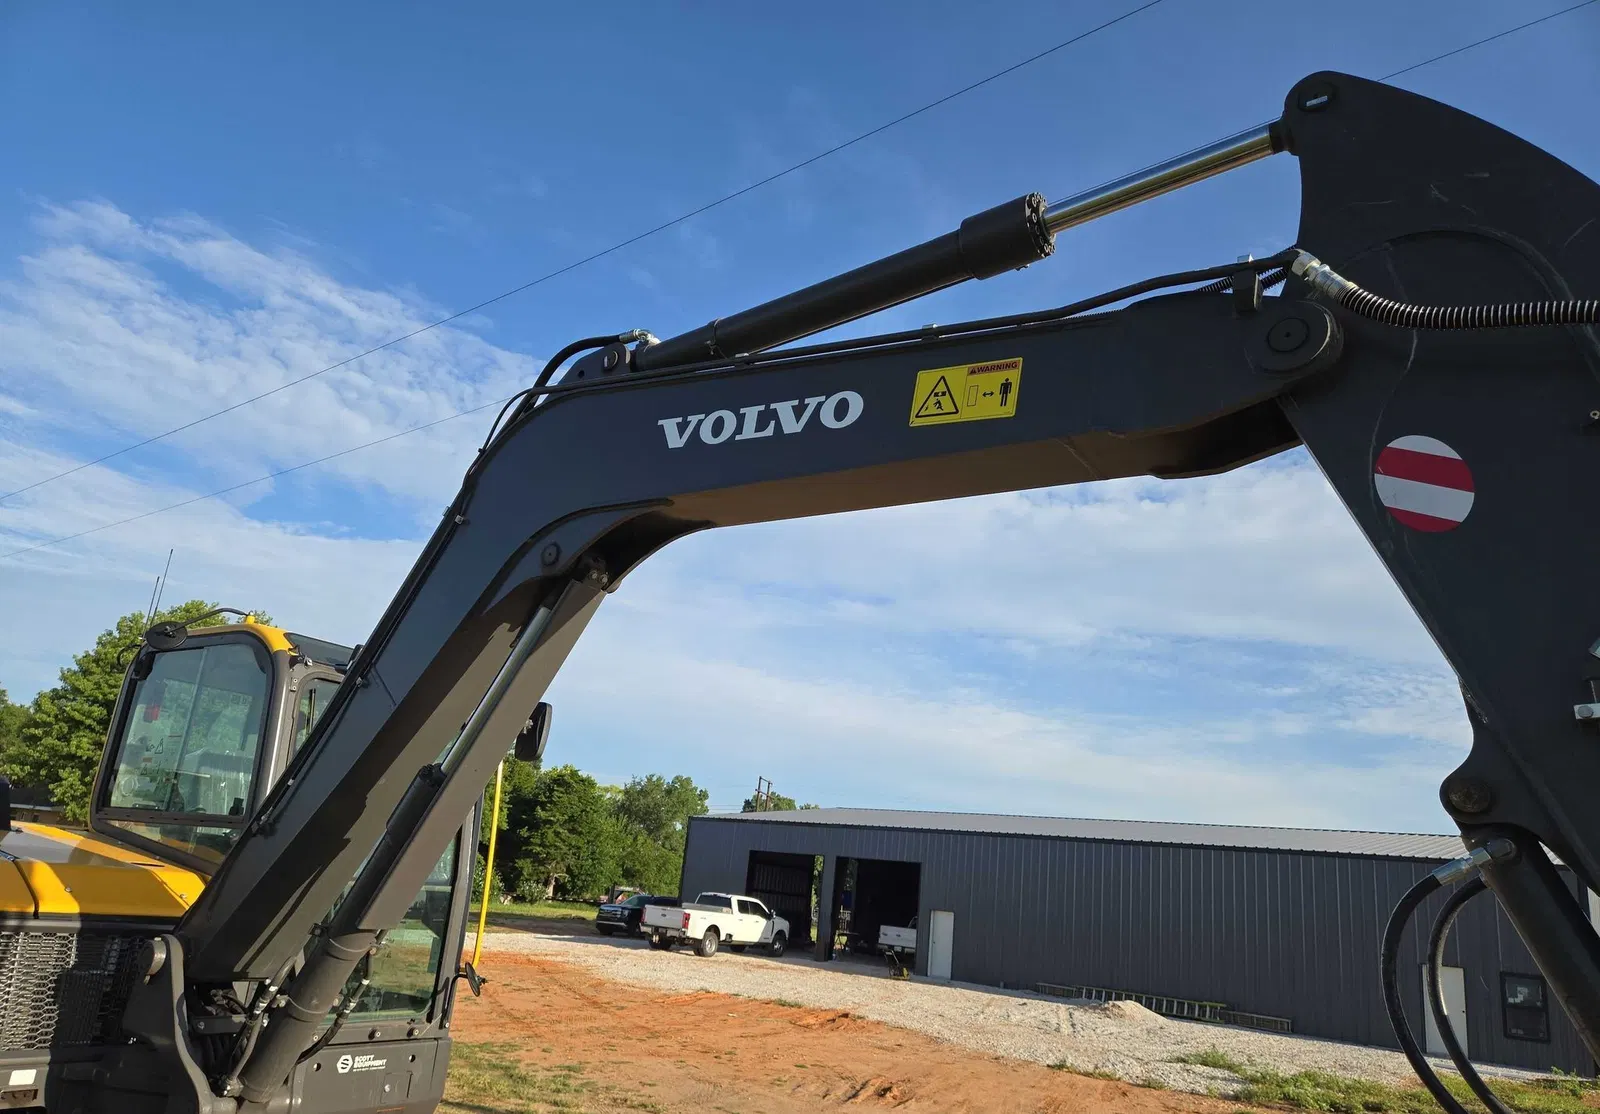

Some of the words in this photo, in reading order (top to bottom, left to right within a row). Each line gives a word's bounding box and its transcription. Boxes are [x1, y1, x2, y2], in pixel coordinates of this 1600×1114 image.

[977, 361, 1018, 373] WARNING
[657, 390, 864, 449] VOLVO
[354, 1054, 375, 1062] SCOTT
[353, 1059, 387, 1068] EQUIPMENT
